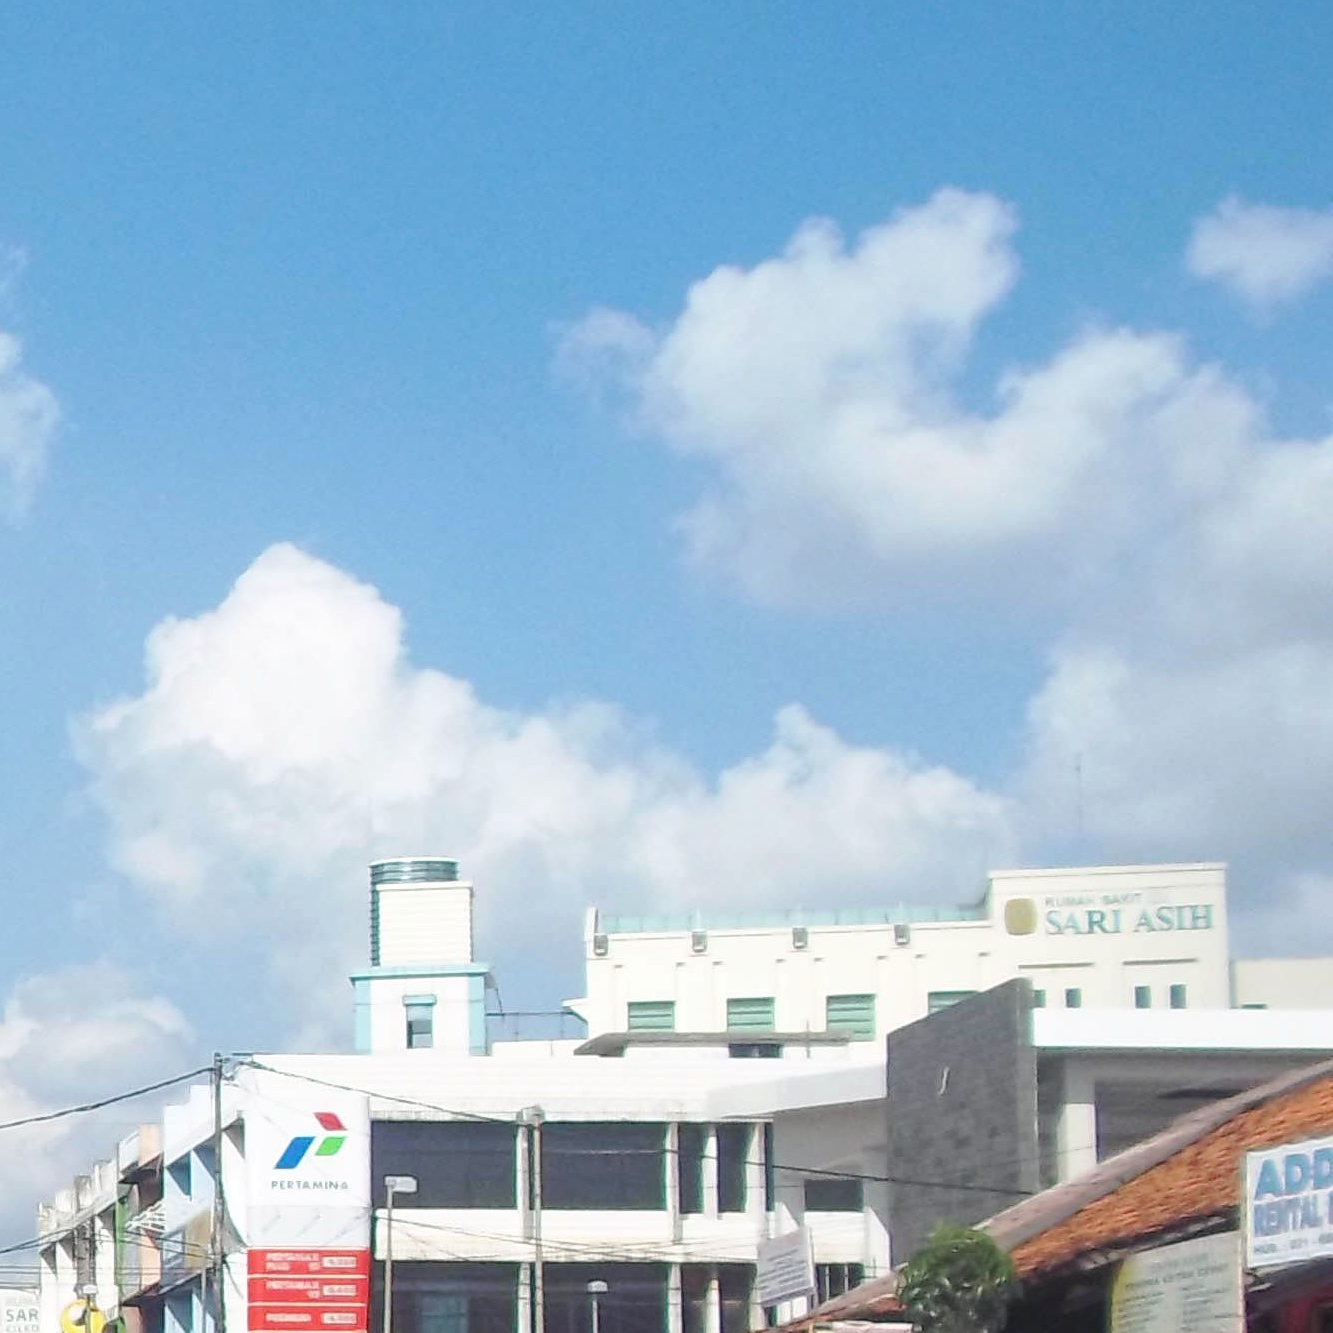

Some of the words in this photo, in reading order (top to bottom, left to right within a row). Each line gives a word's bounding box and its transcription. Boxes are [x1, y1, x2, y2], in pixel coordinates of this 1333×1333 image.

[1045, 908, 1123, 935] SARI
[1132, 903, 1215, 932] ASIH
[270, 1180, 349, 1190] PERTAMINA
[6, 1308, 39, 1323] SAR
